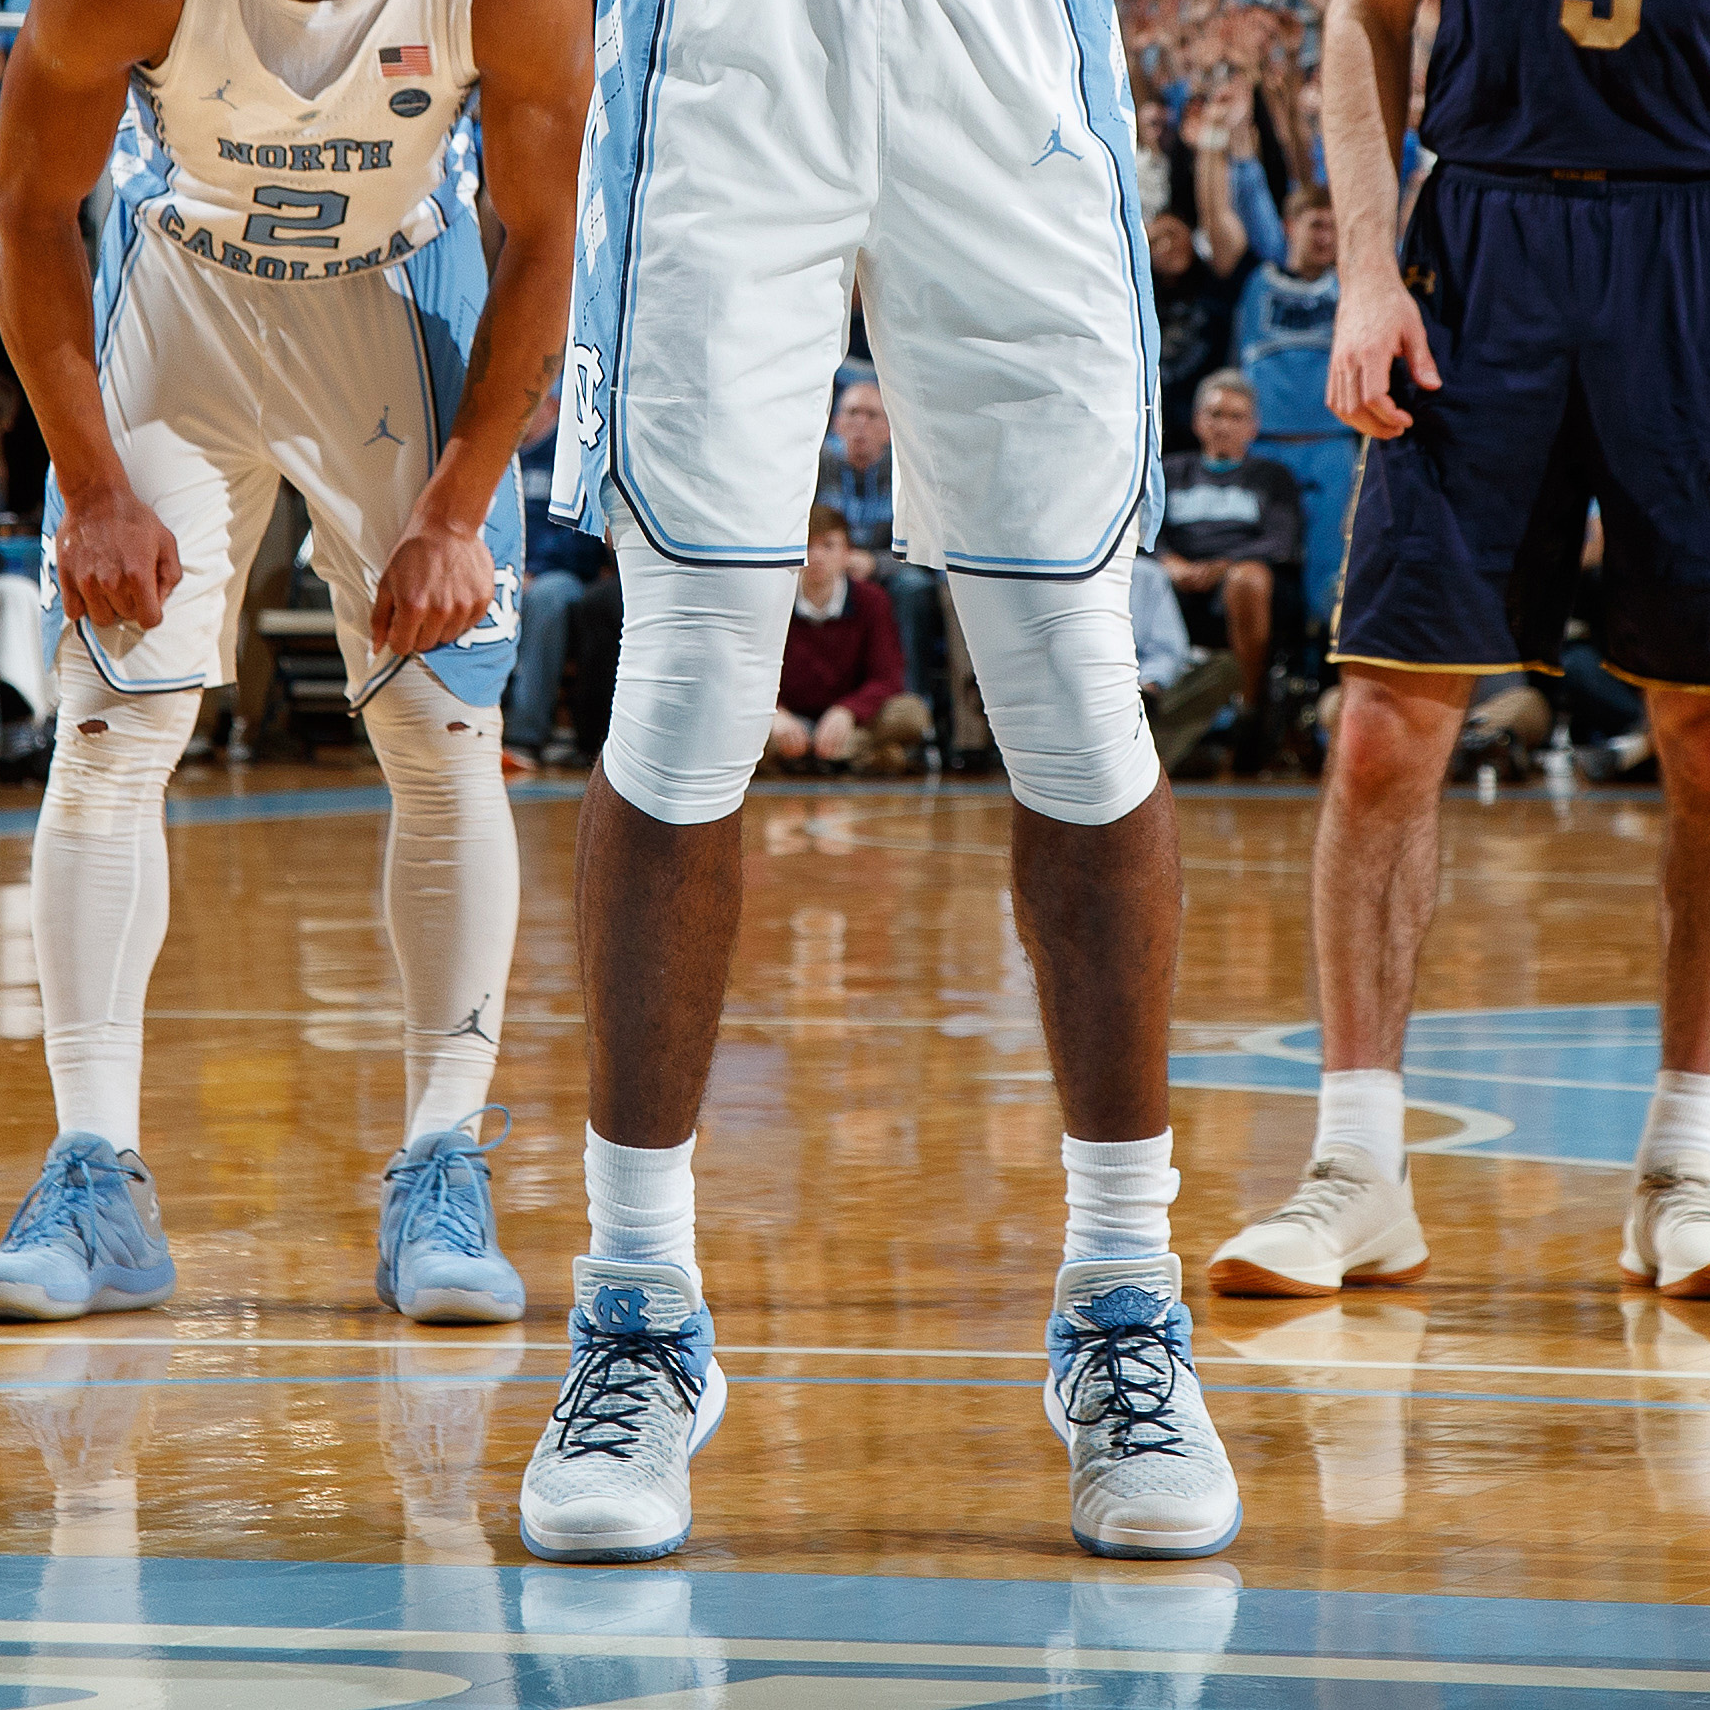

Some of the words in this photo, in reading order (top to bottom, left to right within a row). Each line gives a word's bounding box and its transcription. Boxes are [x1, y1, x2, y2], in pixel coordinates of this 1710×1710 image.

[217, 137, 393, 172] NORTH
[158, 204, 416, 280] CAROLINA
[242, 185, 350, 250] 2
